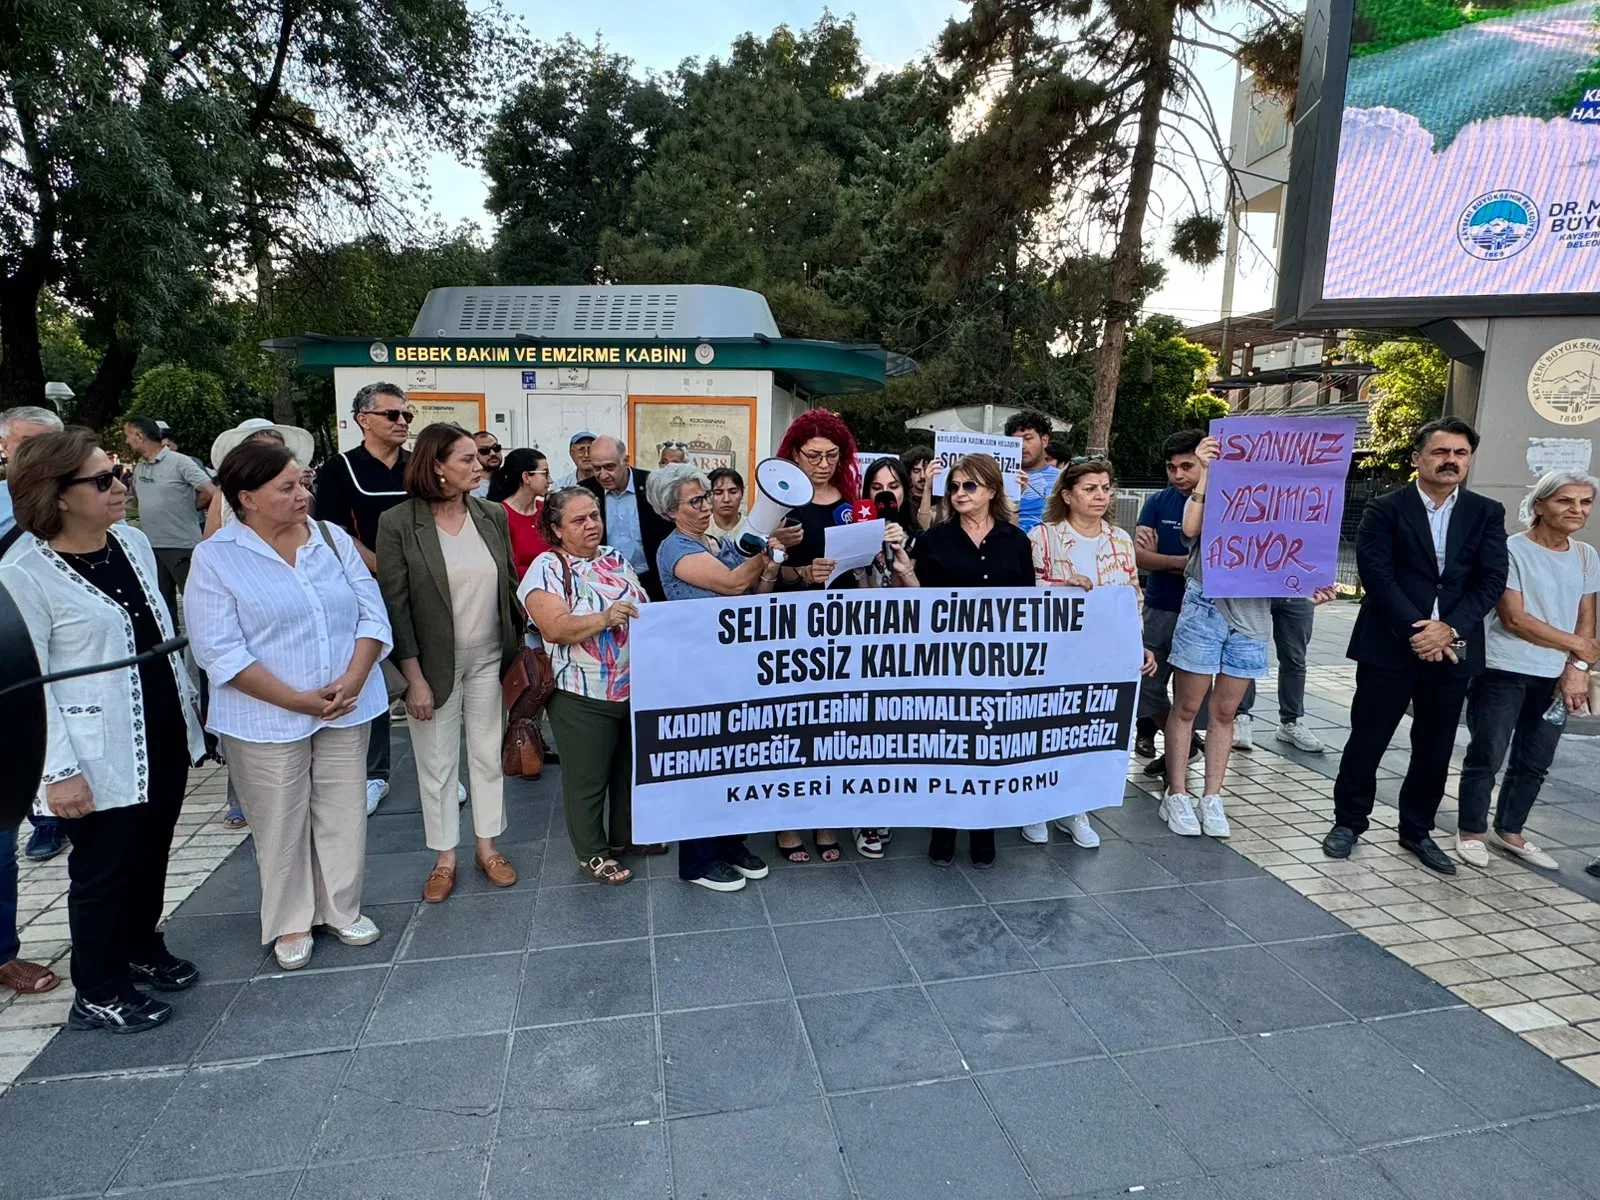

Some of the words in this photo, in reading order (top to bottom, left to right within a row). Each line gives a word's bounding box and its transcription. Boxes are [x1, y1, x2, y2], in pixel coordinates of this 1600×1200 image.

[1548, 201, 1582, 217] DR.
[395, 347, 451, 361] BEBEK
[456, 347, 510, 361] BAKIM
[514, 348, 537, 362] VE
[541, 344, 620, 363] EMZİRME
[1532, 361, 1547, 401] KAYSERİ
[1559, 414, 1584, 423] 1869
[1206, 531, 1317, 572] AŞIYOR
[718, 598, 797, 645] SELİN
[807, 593, 921, 638] GÖKHAN
[930, 591, 1085, 633] CİNAYETİNE
[757, 638, 851, 686] SESSİZ
[861, 642, 1048, 679] KALMIYORUZ!
[658, 711, 721, 740] KADIN
[727, 692, 869, 733] CİNAYETLERİNİ
[874, 687, 1083, 730] NORMALLEŞTİRMENİZE
[1085, 684, 1118, 713] İZİN
[649, 734, 807, 777] VERMEYECEĞİZ,
[813, 728, 969, 761] MÜCADELEMİZE
[975, 731, 1037, 760] DEVAM
[1041, 718, 1118, 753] EDECEĞİZ!
[727, 775, 831, 803] KAYSERİ
[842, 777, 918, 794] KADIN
[928, 770, 1059, 795] PLATFORMU
